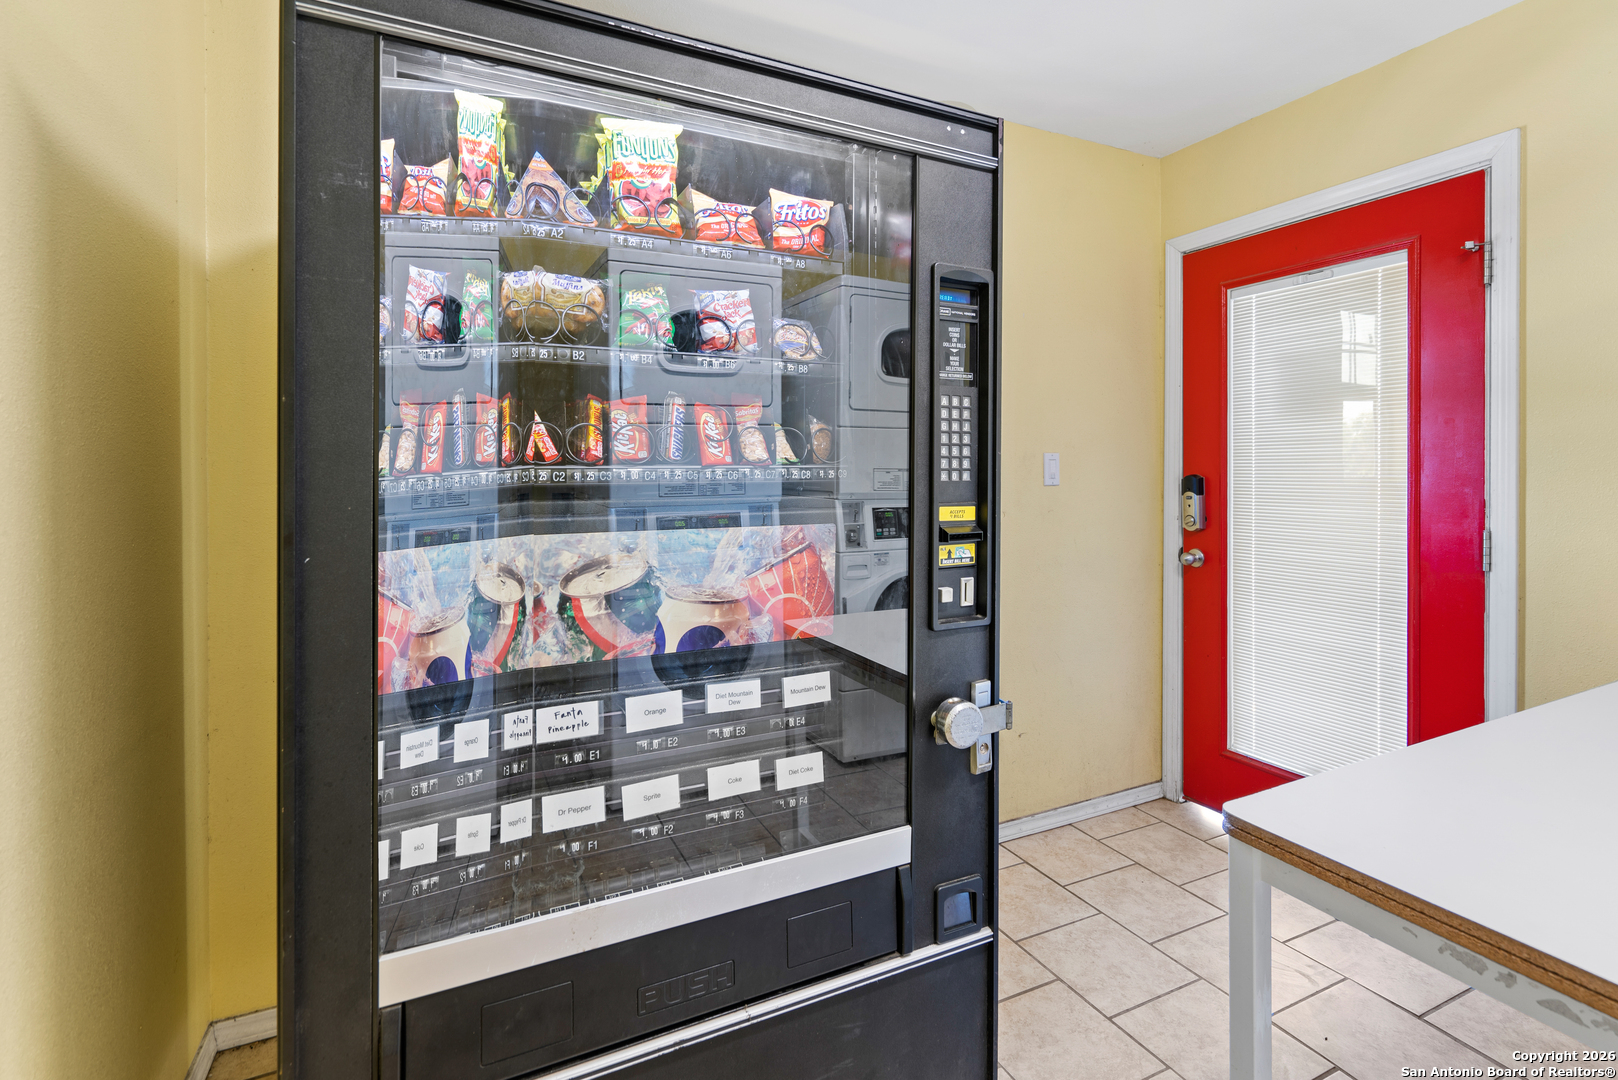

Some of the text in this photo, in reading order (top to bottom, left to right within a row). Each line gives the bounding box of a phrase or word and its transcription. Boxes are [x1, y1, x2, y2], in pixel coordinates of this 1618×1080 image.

[774, 200, 828, 222] Fritos
[550, 228, 564, 239] A2
[641, 239, 653, 249] A4
[721, 250, 732, 260] A6
[795, 259, 806, 269] A8
[552, 279, 584, 291] Muffins
[629, 285, 663, 305] Takis
[713, 298, 750, 312] Cracker
[722, 309, 741, 321] Jack
[572, 350, 585, 360] B2
[641, 355, 653, 364] B4
[798, 364, 808, 373] B8
[553, 472, 565, 481] C2
[600, 471, 612, 480] C3
[645, 471, 656, 481] C4
[687, 471, 698, 480] C5
[727, 471, 738, 480] C6
[765, 471, 776, 479] C7
[801, 471, 811, 479] C8
[837, 470, 847, 478] C9
[727, 690, 753, 698] Mountain
[790, 684, 826, 694] Mountain Dew
[554, 707, 583, 720] Fanta
[644, 706, 667, 717] Orange
[796, 716, 806, 726] E4
[736, 727, 746, 736] E3
[667, 737, 678, 747] E2
[589, 750, 600, 760] E1
[788, 766, 814, 776] Diet Coke
[727, 776, 742, 784] Coke
[643, 792, 661, 802] Sprite
[799, 796, 808, 805] F4
[558, 804, 592, 816] Dr Pepper
[735, 810, 745, 820] F3
[663, 825, 674, 835] F2
[588, 841, 598, 851] F1
[641, 965, 733, 1012] PUSH
